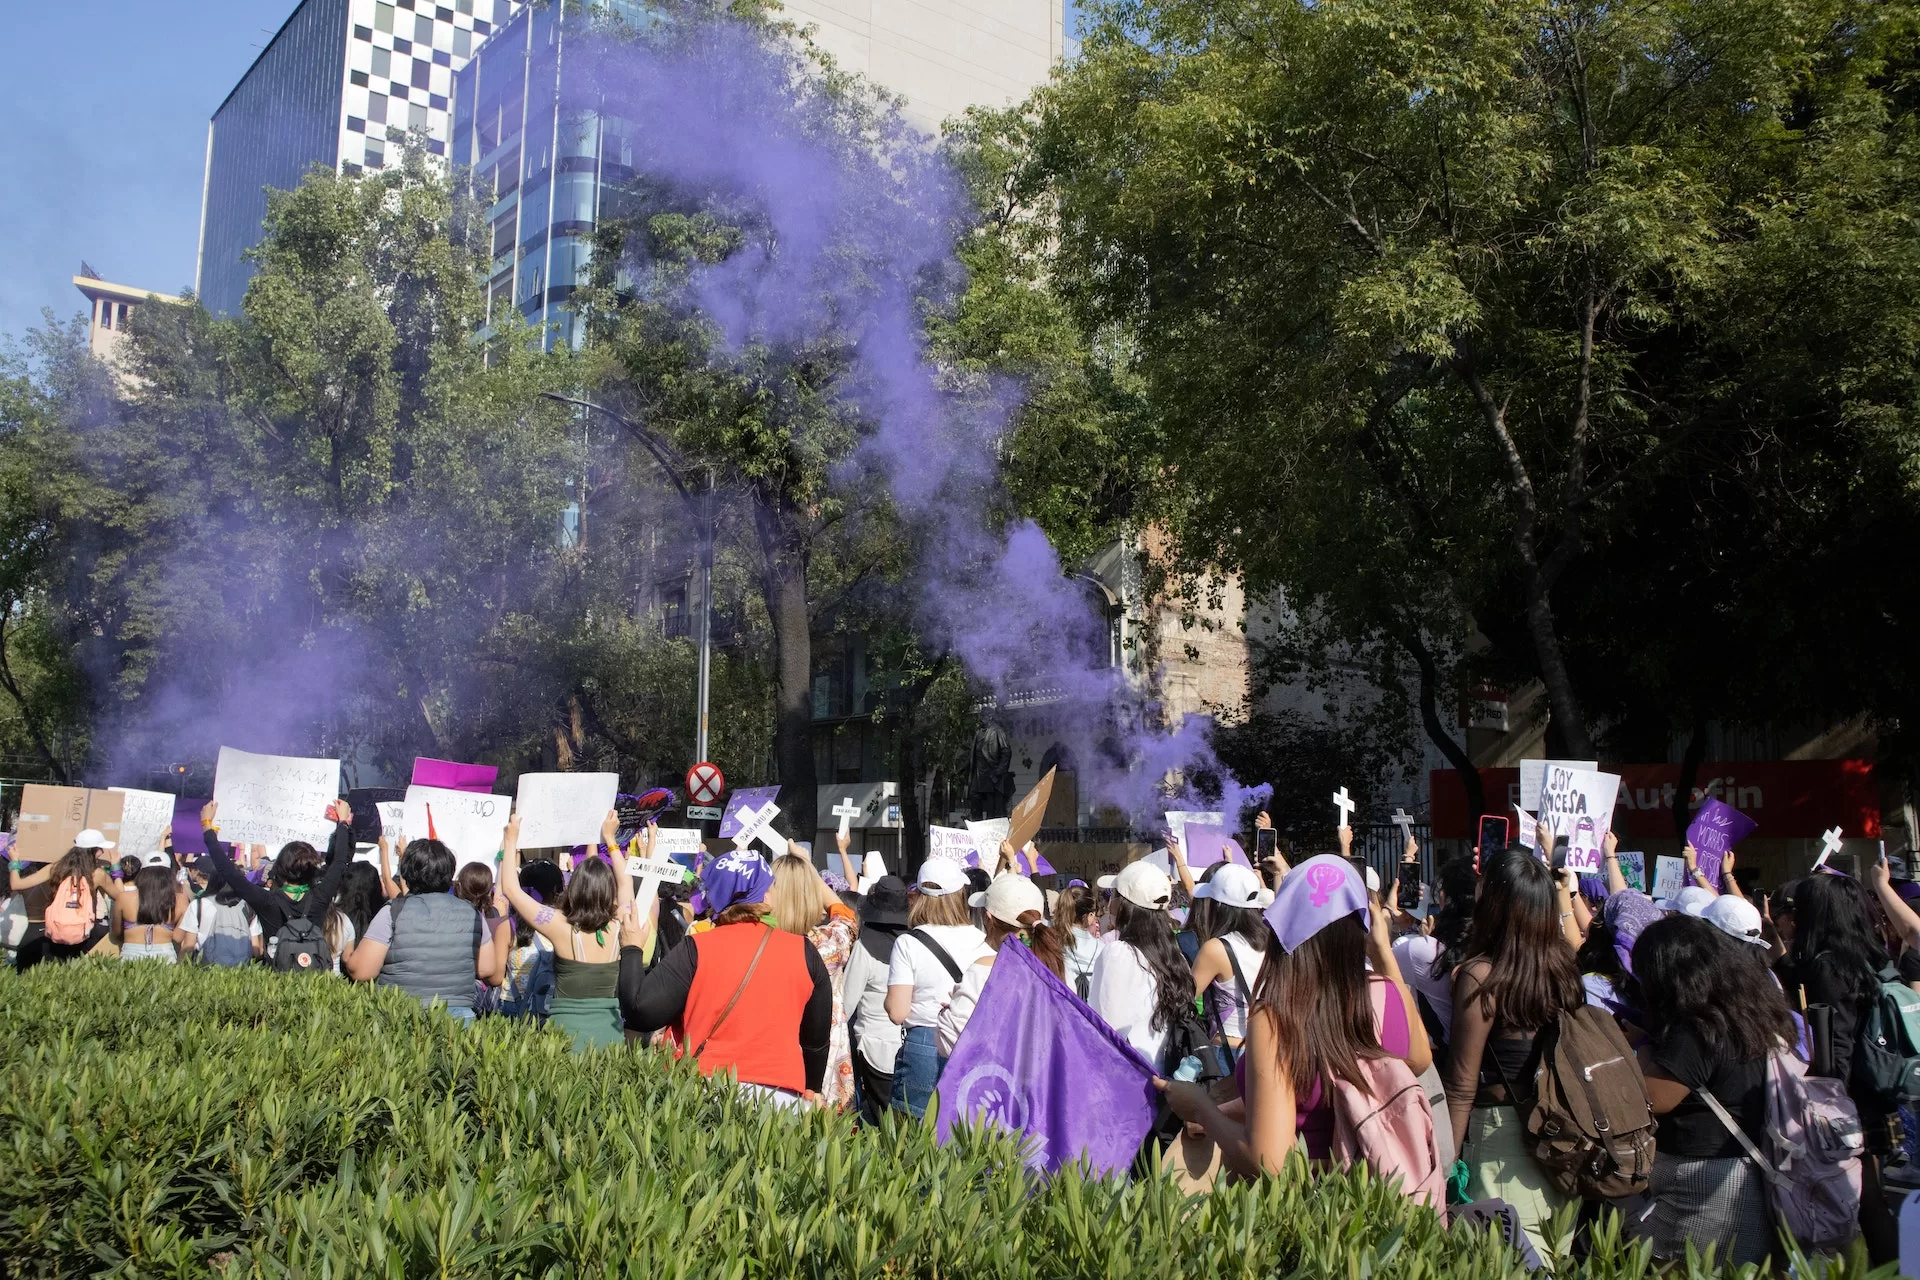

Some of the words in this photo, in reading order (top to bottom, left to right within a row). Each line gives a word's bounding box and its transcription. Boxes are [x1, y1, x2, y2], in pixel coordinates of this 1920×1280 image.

[1551, 767, 1573, 791] SOY
[932, 847, 943, 857] NO
[1667, 861, 1679, 871] MI
